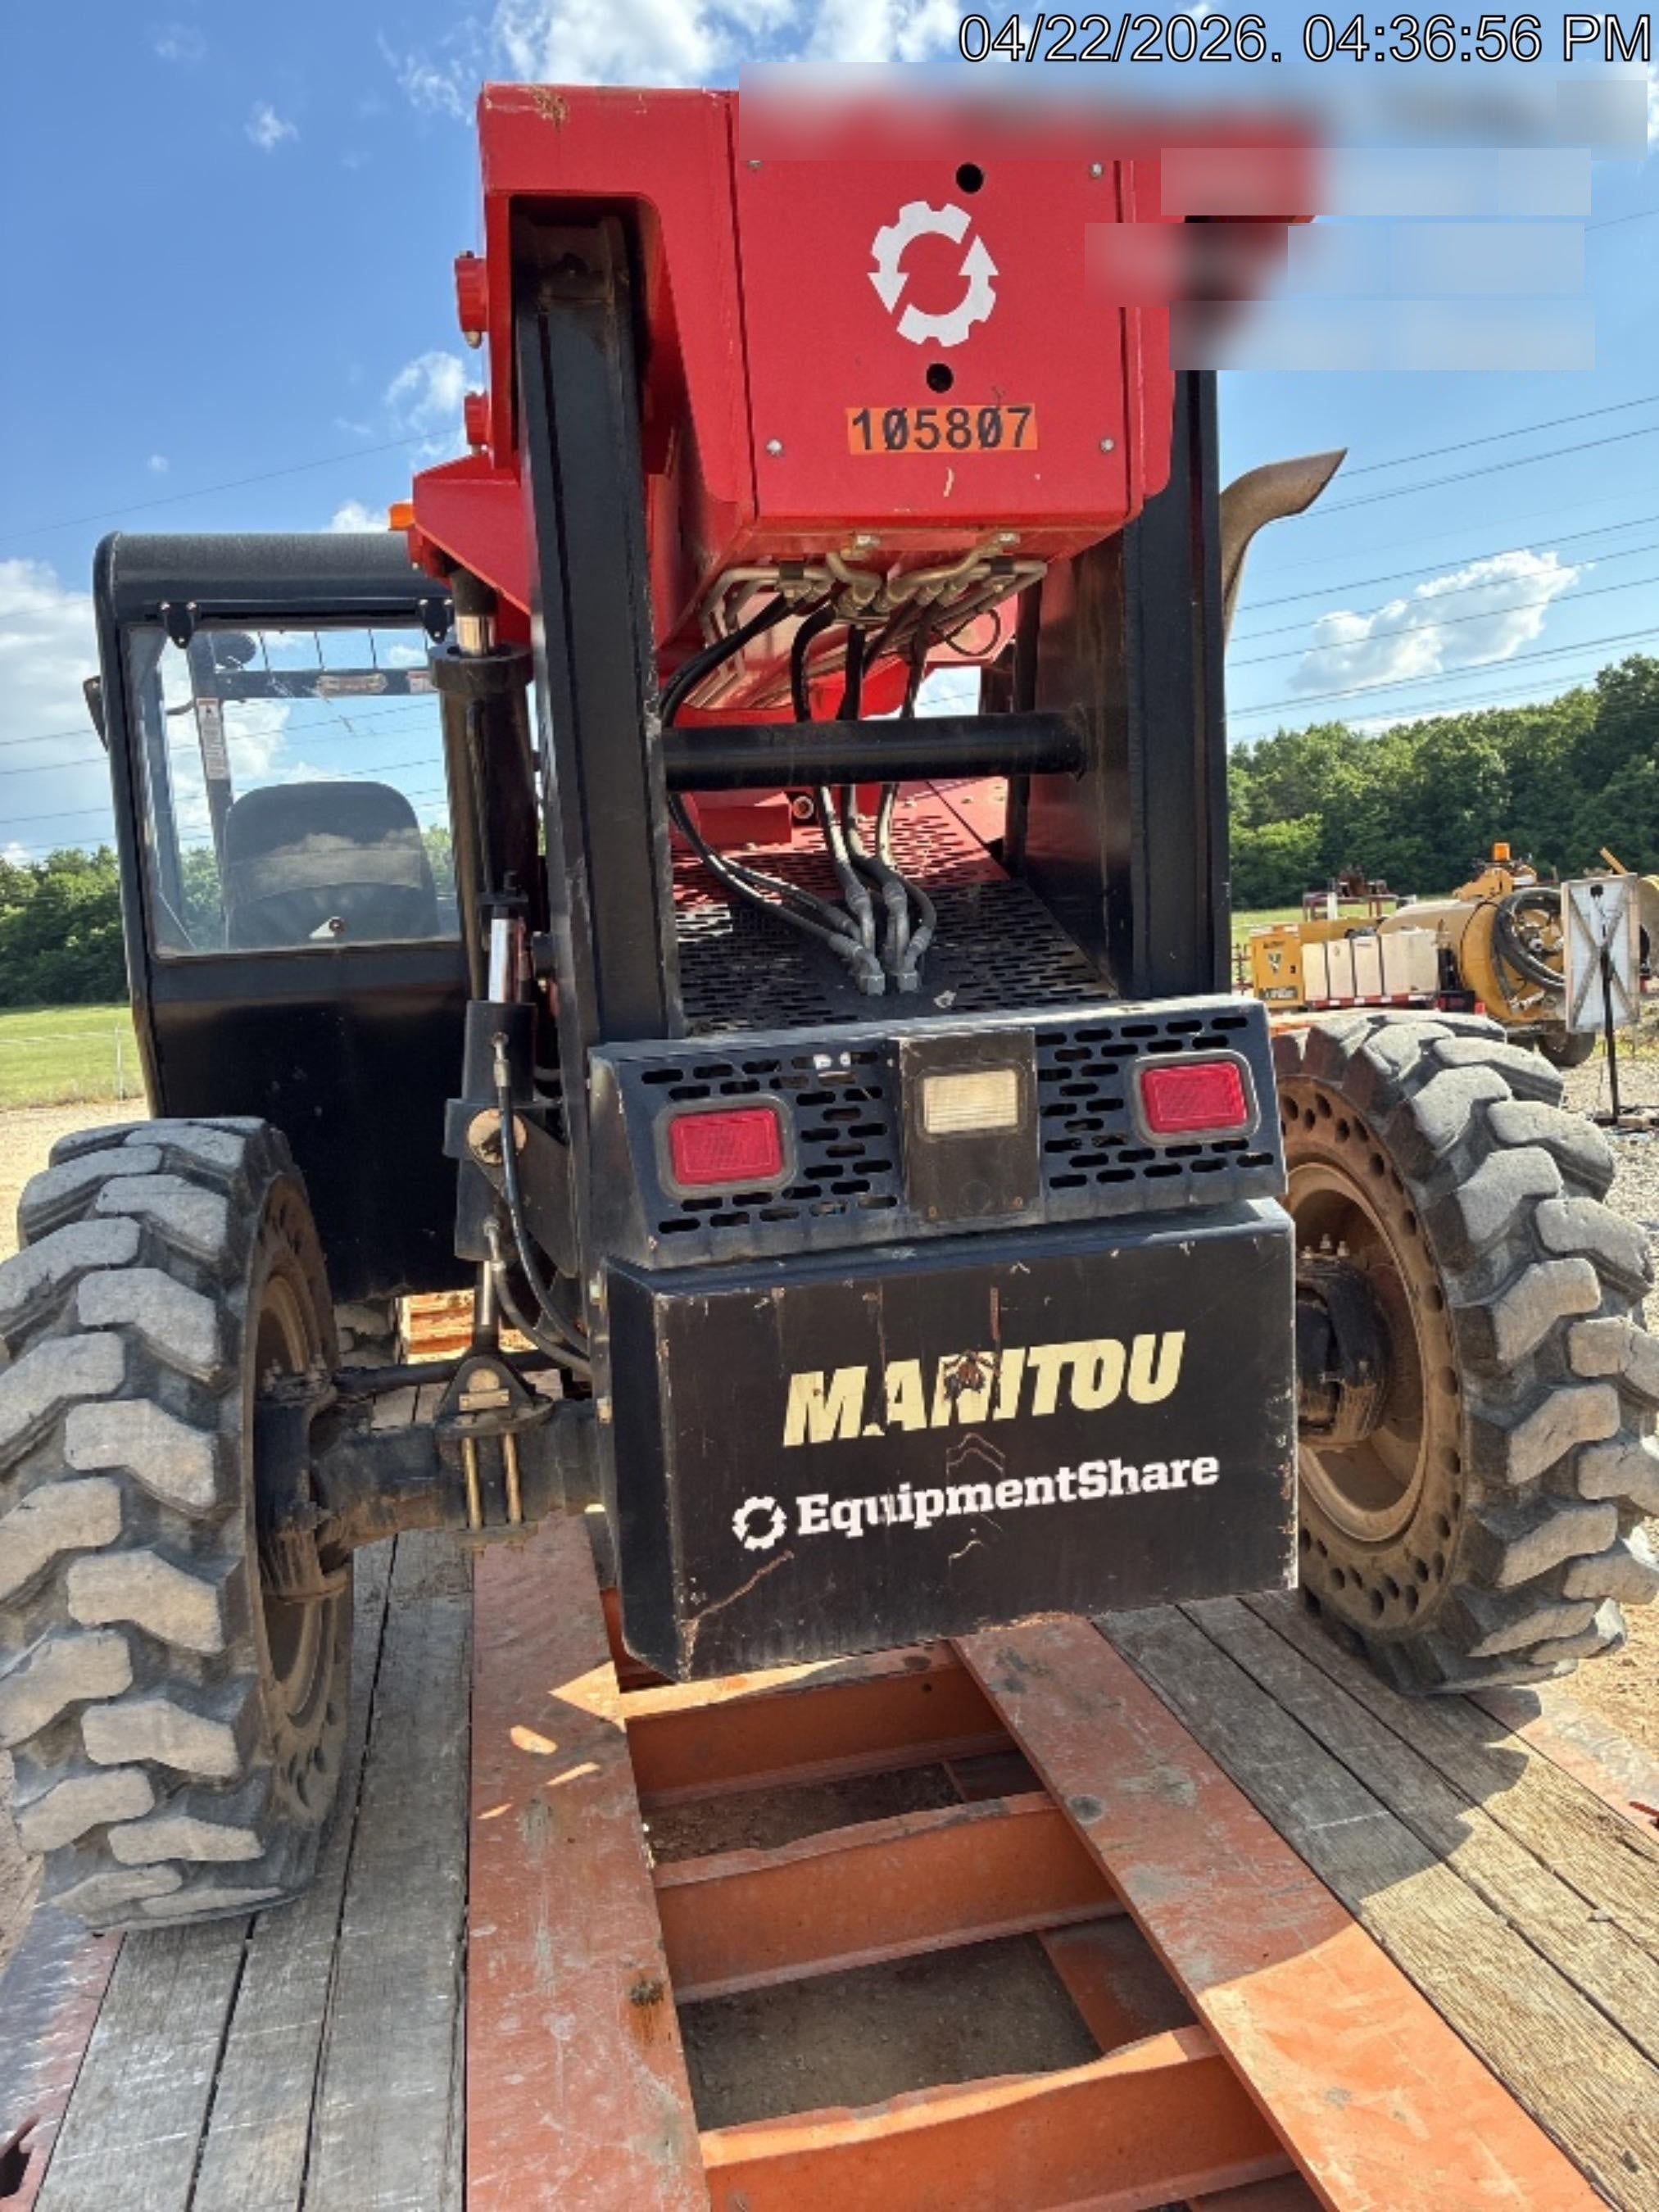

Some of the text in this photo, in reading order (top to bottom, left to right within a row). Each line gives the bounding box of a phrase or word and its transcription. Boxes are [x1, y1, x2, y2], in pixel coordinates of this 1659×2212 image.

[852, 405, 1033, 451] 105807
[782, 1330, 1186, 1448] MANITOU
[795, 1455, 1221, 1539] EquipmentShare
